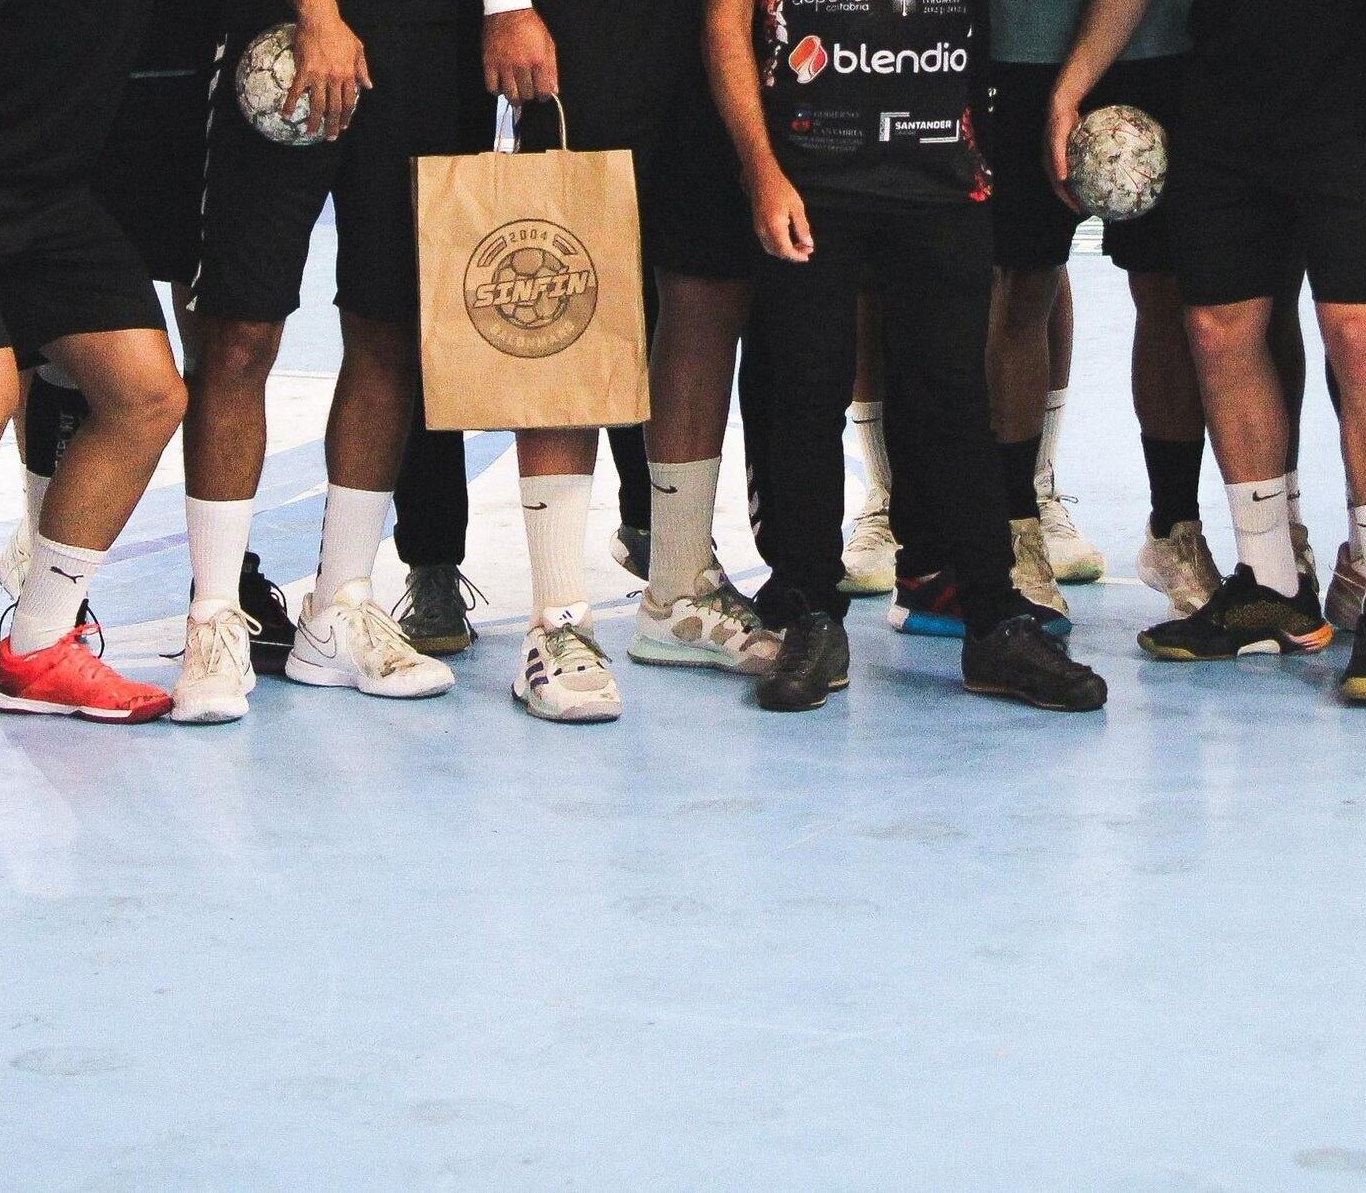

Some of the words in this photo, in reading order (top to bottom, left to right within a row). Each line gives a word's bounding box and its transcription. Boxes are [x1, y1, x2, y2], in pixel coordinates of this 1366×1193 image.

[833, 42, 967, 74] blendio
[894, 119, 953, 131] SANTANDER
[509, 228, 549, 243] 2004
[473, 269, 591, 308] SINFIN
